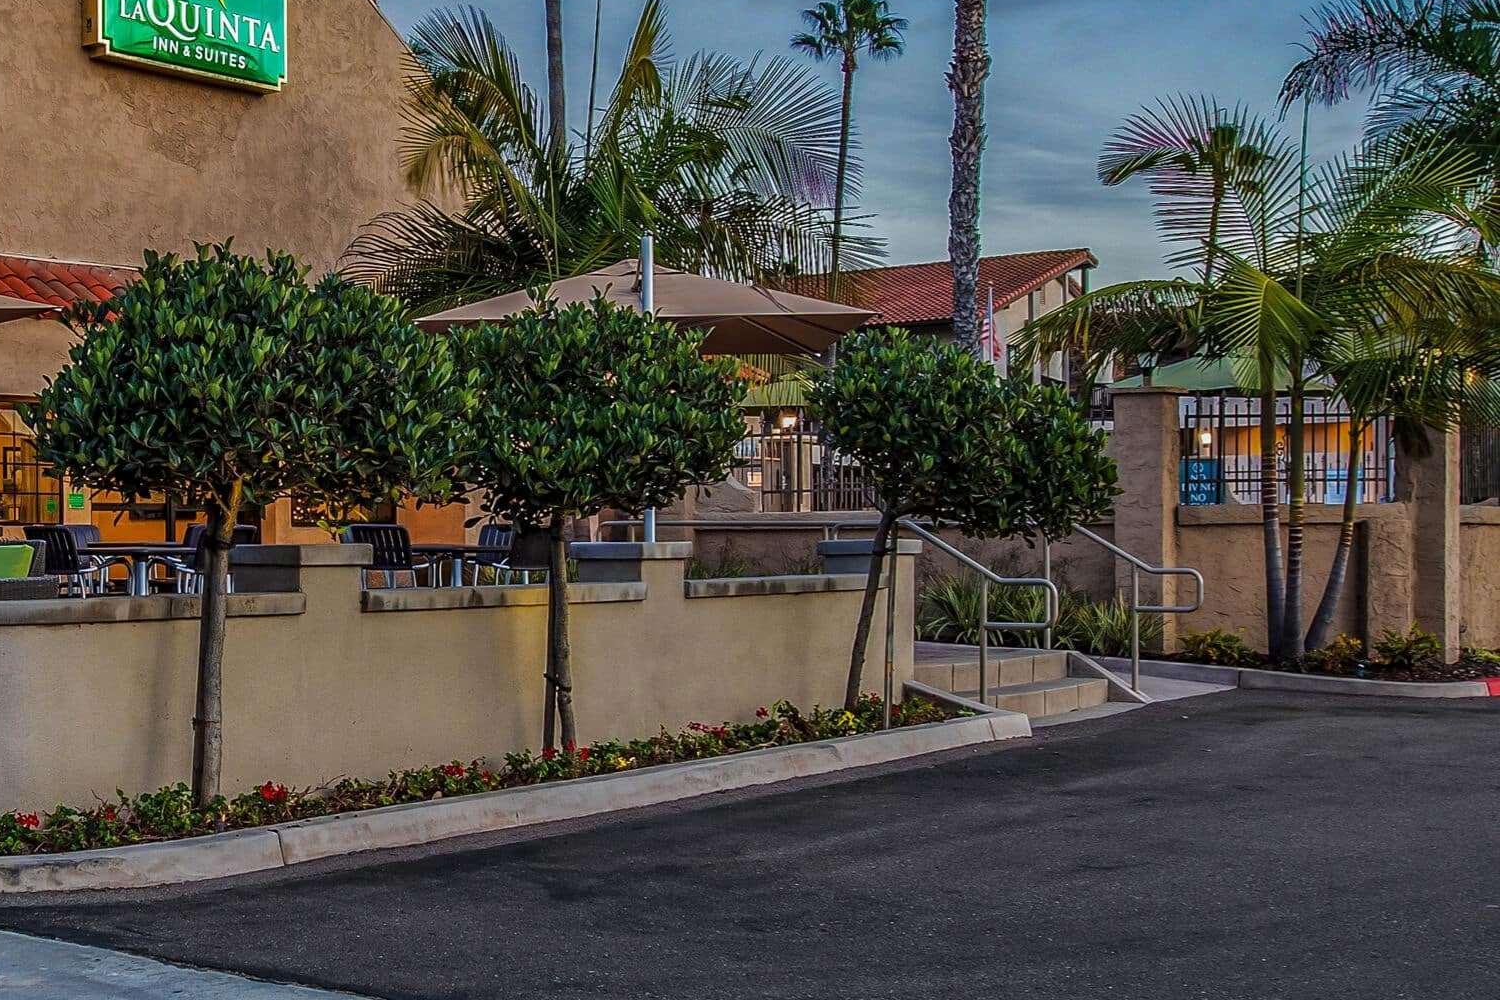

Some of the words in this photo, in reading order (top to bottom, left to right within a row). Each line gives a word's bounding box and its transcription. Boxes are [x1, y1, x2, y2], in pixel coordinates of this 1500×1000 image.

[153, 35, 179, 55] INN
[182, 45, 192, 58] &
[194, 45, 247, 70] SUITES
[1190, 493, 1207, 502] NO
